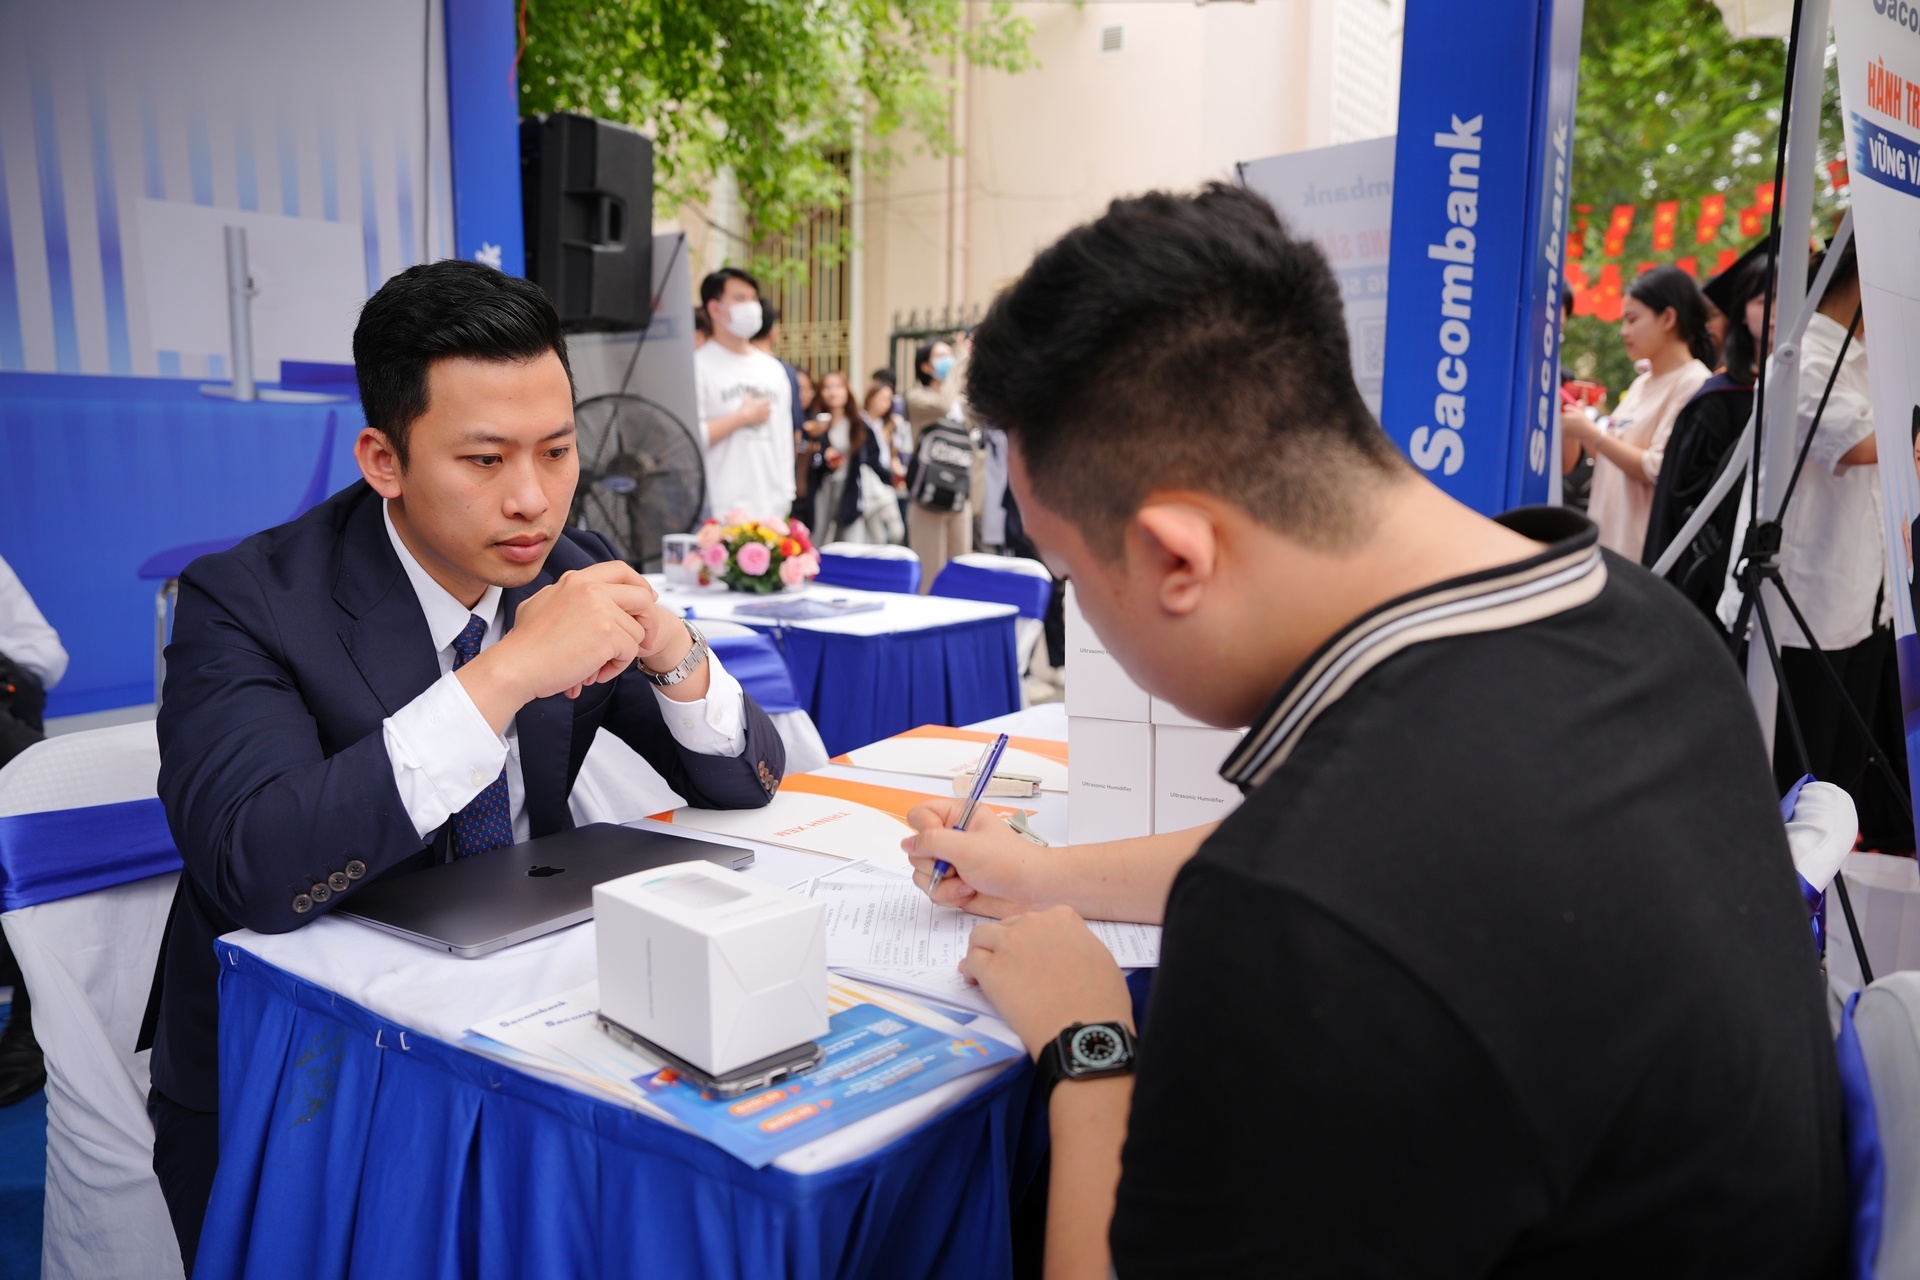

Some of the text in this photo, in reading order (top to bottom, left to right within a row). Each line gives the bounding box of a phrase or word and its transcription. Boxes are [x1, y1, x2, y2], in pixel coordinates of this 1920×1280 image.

[1868, 54, 1920, 131] HÀNH TR
[1868, 132, 1906, 180] VỮNG
[1409, 113, 1484, 476] Sacombank
[1529, 117, 1568, 477] Sacombank
[1079, 647, 1105, 655] Ultrasonic
[1081, 780, 1132, 792] Ultrasonic Humidifier
[1169, 792, 1225, 804] Ultrasonic Humidifier
